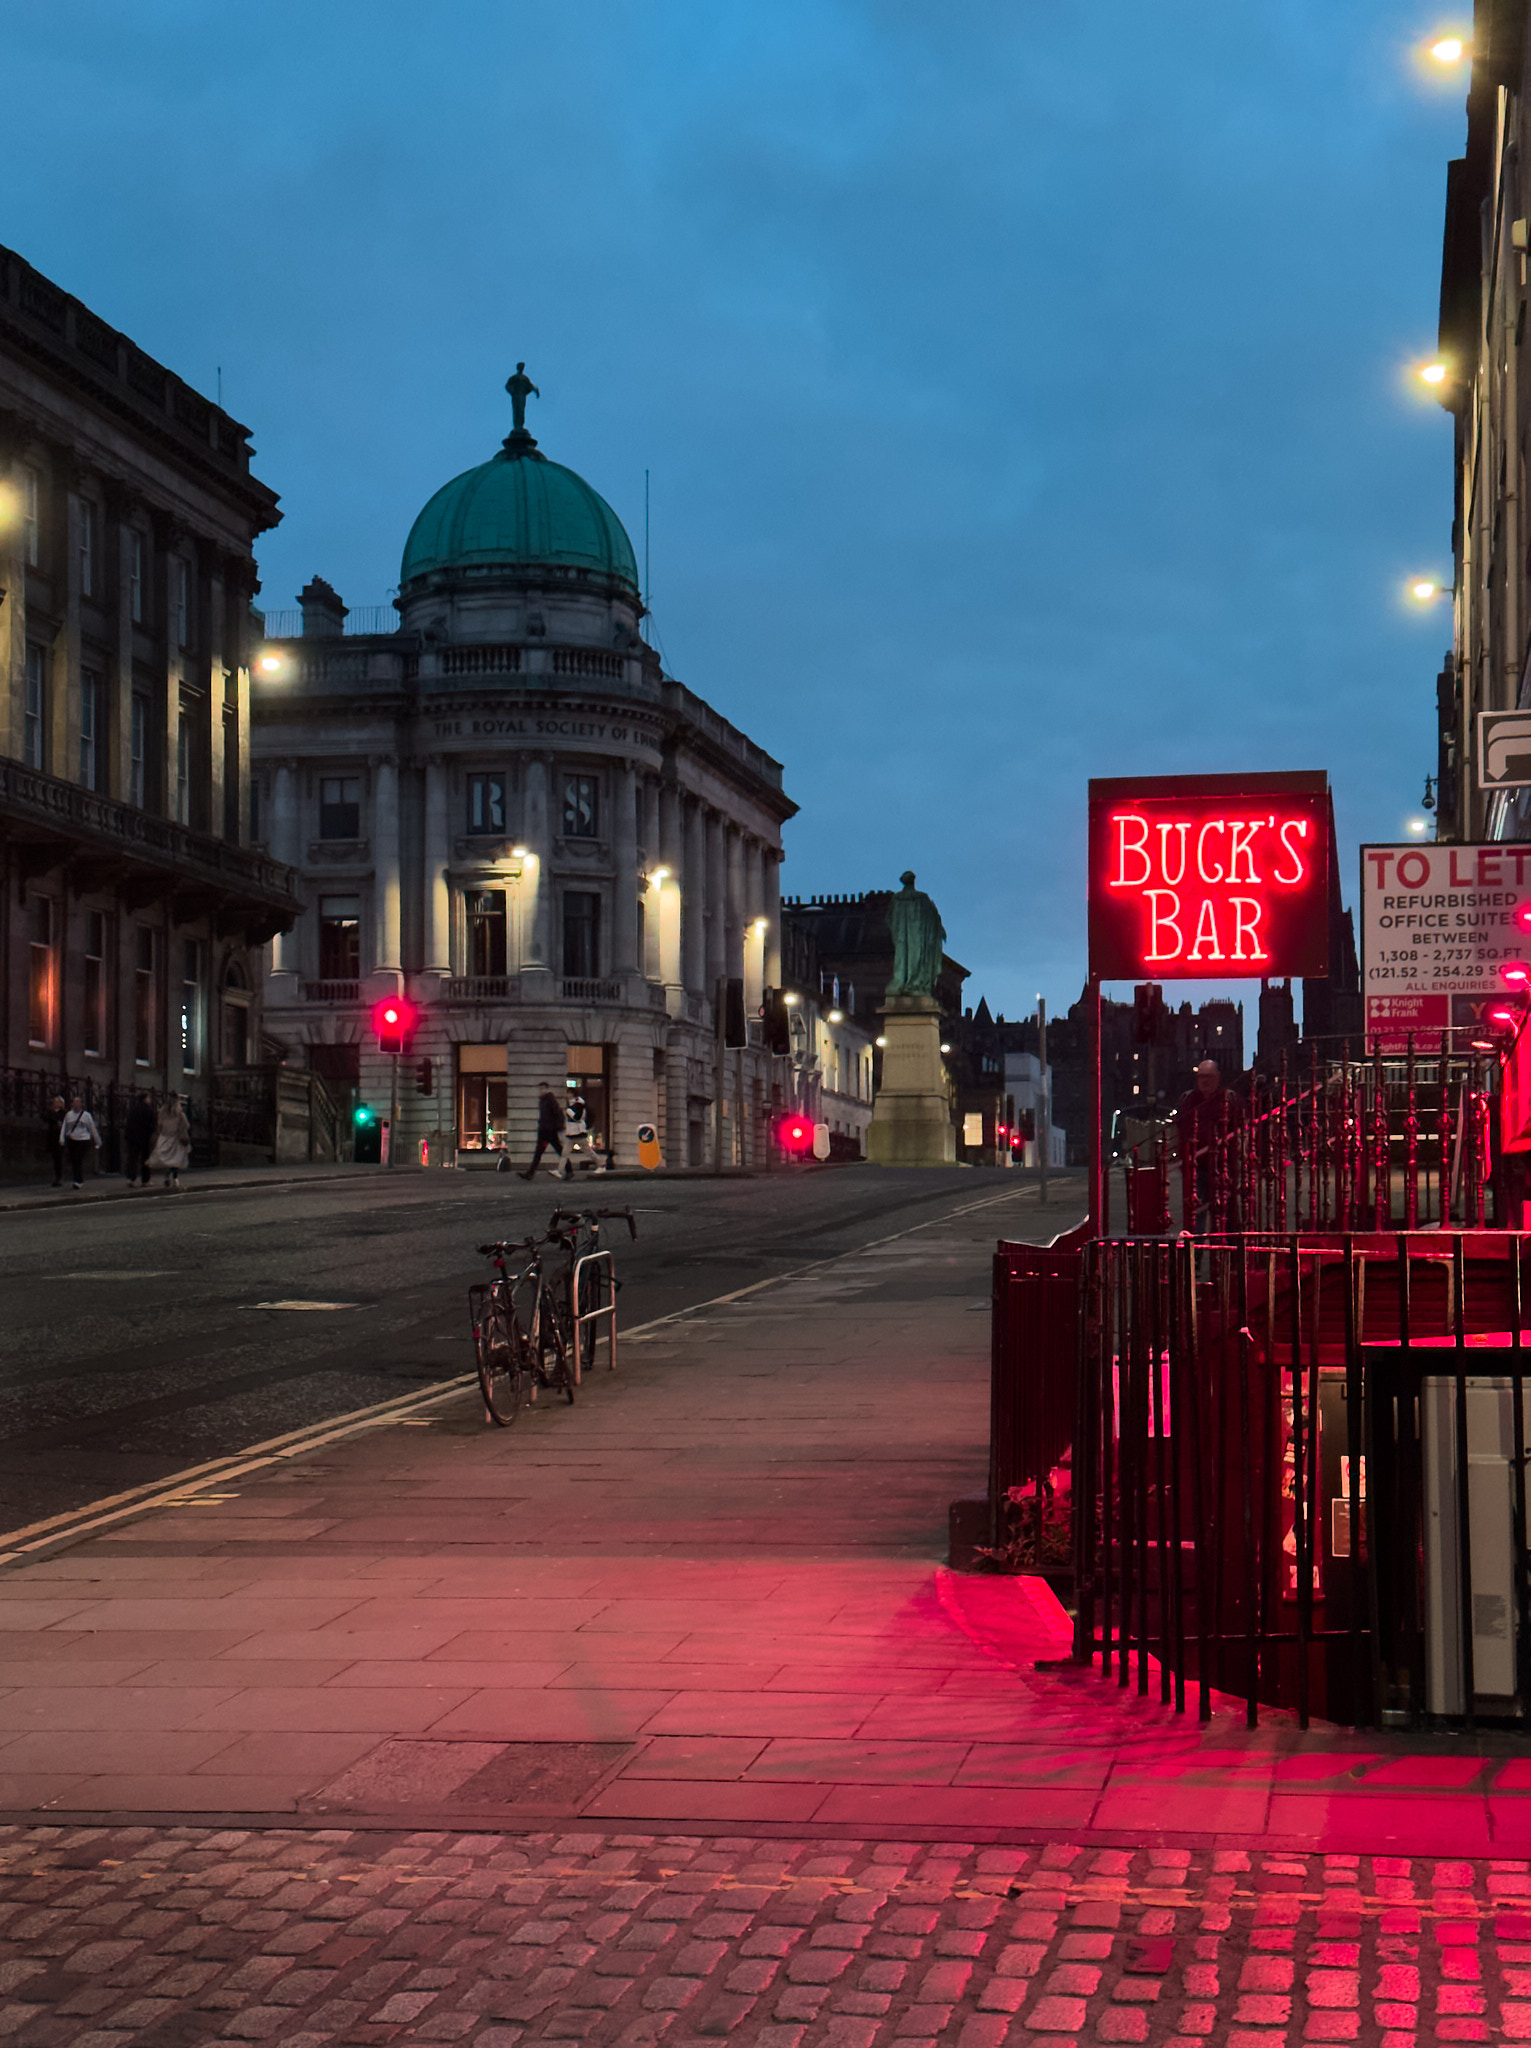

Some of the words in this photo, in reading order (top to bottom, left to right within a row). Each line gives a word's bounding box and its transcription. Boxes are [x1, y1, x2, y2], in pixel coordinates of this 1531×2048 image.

[434, 721, 462, 736] THE
[472, 719, 527, 734] ROYAL
[536, 720, 607, 738] SOCIETY
[611, 725, 629, 741] OF
[1109, 815, 1307, 887] BUCK'S
[1368, 851, 1431, 889] TO
[1449, 849, 1531, 887] LET
[1383, 893, 1518, 909] REFURBISHED
[1142, 889, 1268, 961] BAR
[1379, 914, 1449, 928] OFFICE
[1412, 932, 1489, 944] BETWEEN
[1380, 950, 1418, 964] 1,308
[1433, 949, 1472, 963] 2,737
[1477, 947, 1522, 961] SQ.FT
[1369, 967, 1418, 980] (121.52
[1433, 965, 1484, 978] 254.29
[1405, 982, 1428, 991] ALL
[1431, 980, 1497, 991] ENQUIRIES
[1391, 997, 1424, 1009] Knight
[1392, 1008, 1419, 1017] Frank
